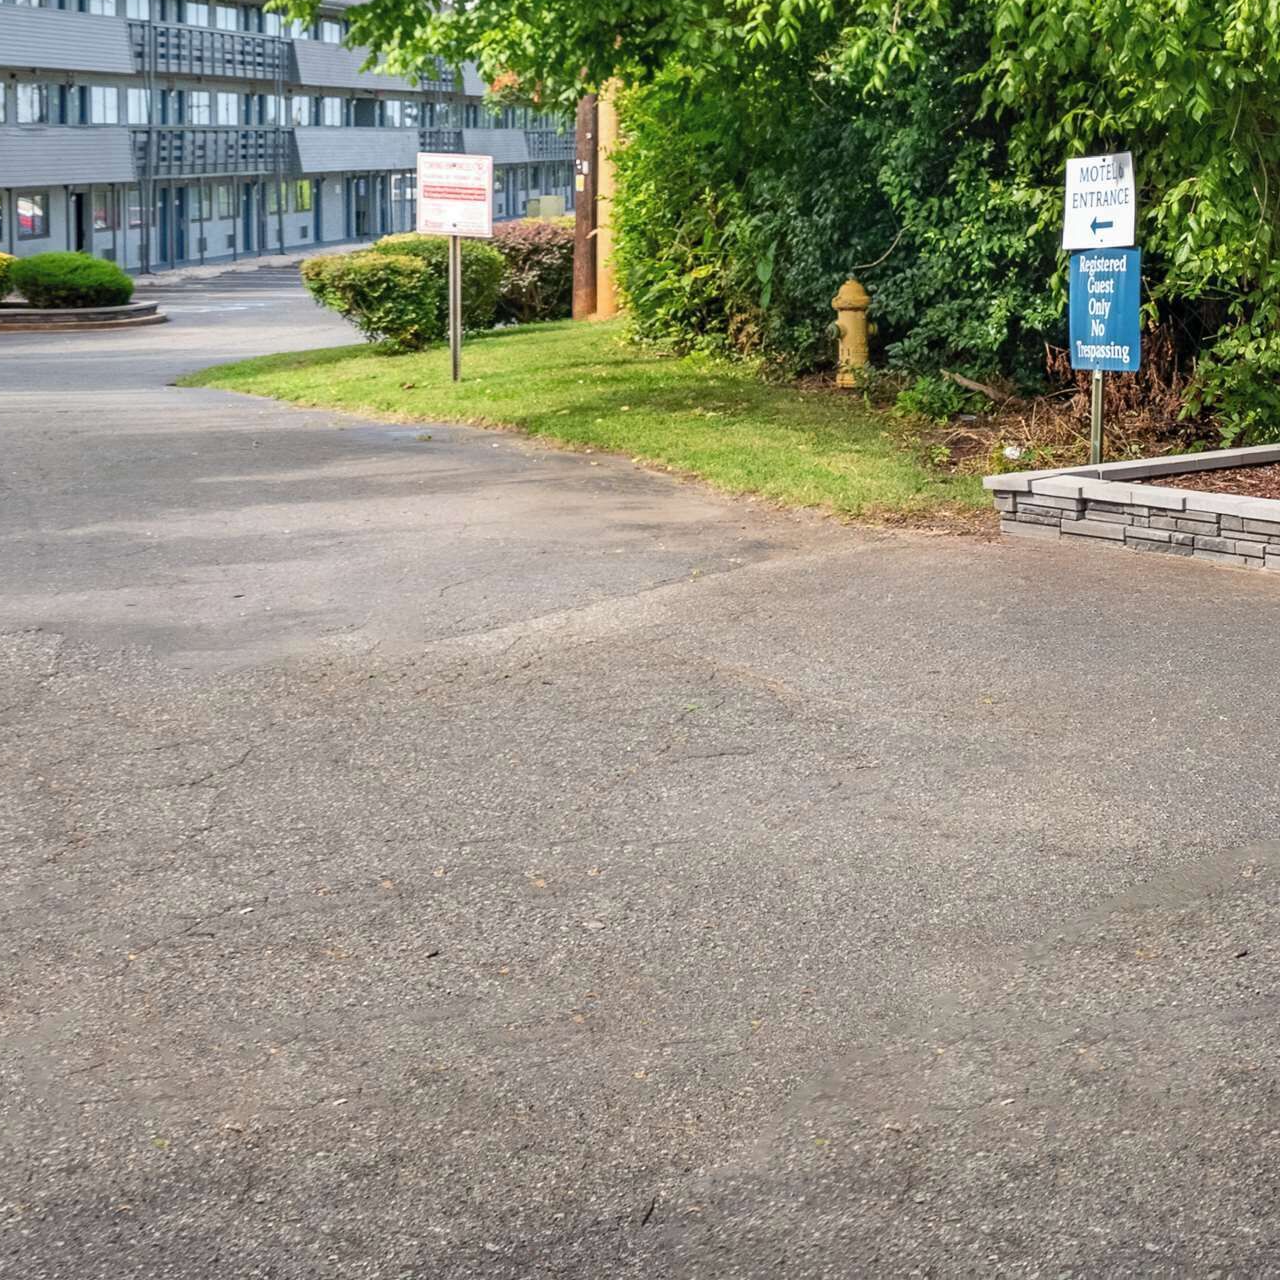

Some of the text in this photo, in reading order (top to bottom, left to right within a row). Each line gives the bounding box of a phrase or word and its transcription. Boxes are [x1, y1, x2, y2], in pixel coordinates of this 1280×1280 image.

[1073, 187, 1129, 209] ENTRANCE
[1079, 255, 1127, 276] Registered
[1087, 276, 1114, 294] Guest
[1088, 298, 1111, 319] Only
[1091, 319, 1105, 337] No
[1076, 340, 1130, 363] Trespassing
